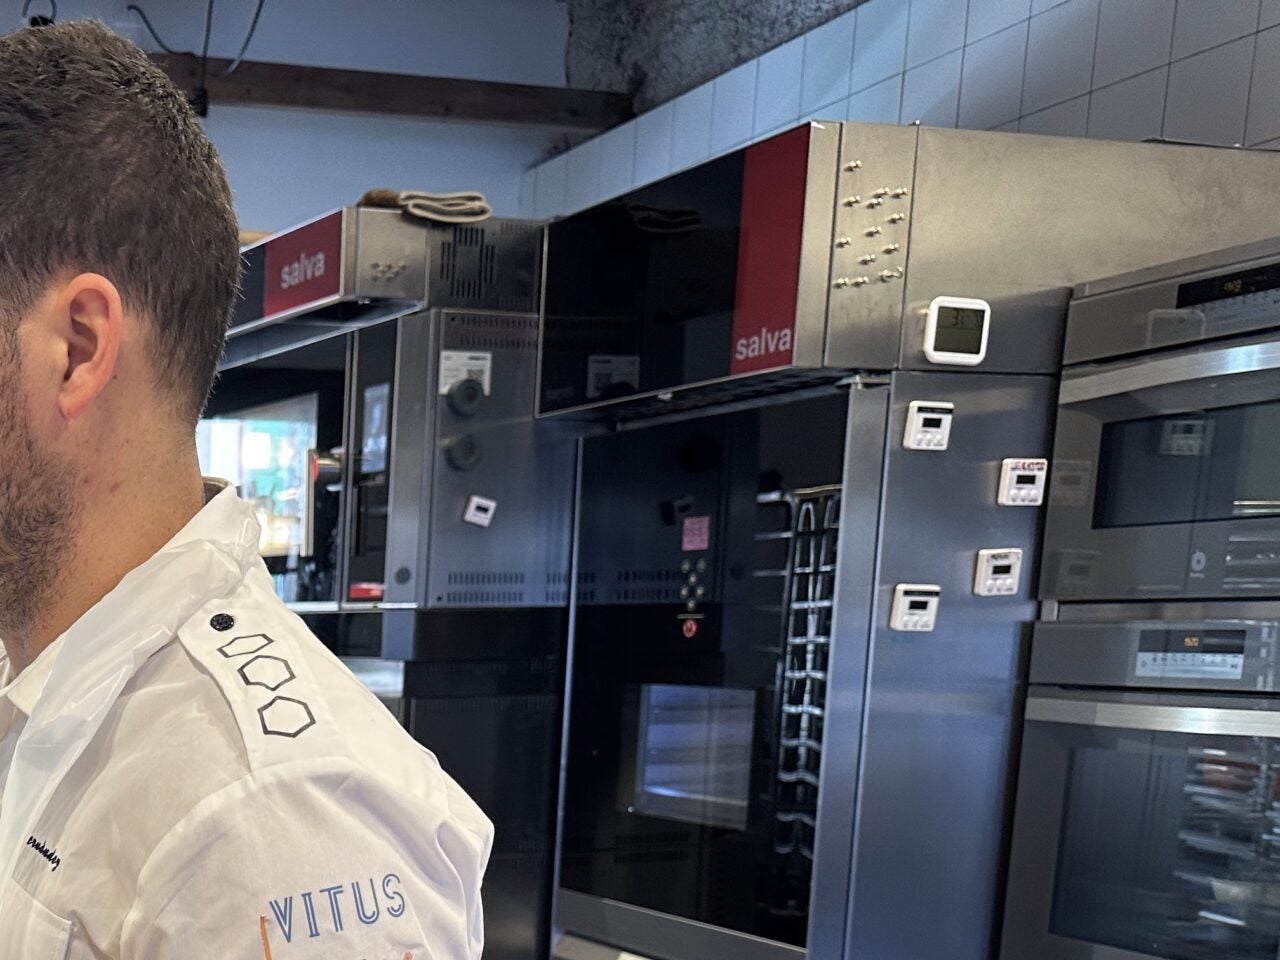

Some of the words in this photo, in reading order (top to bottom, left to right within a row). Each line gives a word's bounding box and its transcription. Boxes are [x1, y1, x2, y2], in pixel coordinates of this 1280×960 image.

[281, 251, 325, 290] salva
[735, 327, 792, 360] salva
[268, 873, 405, 943] VITUS
